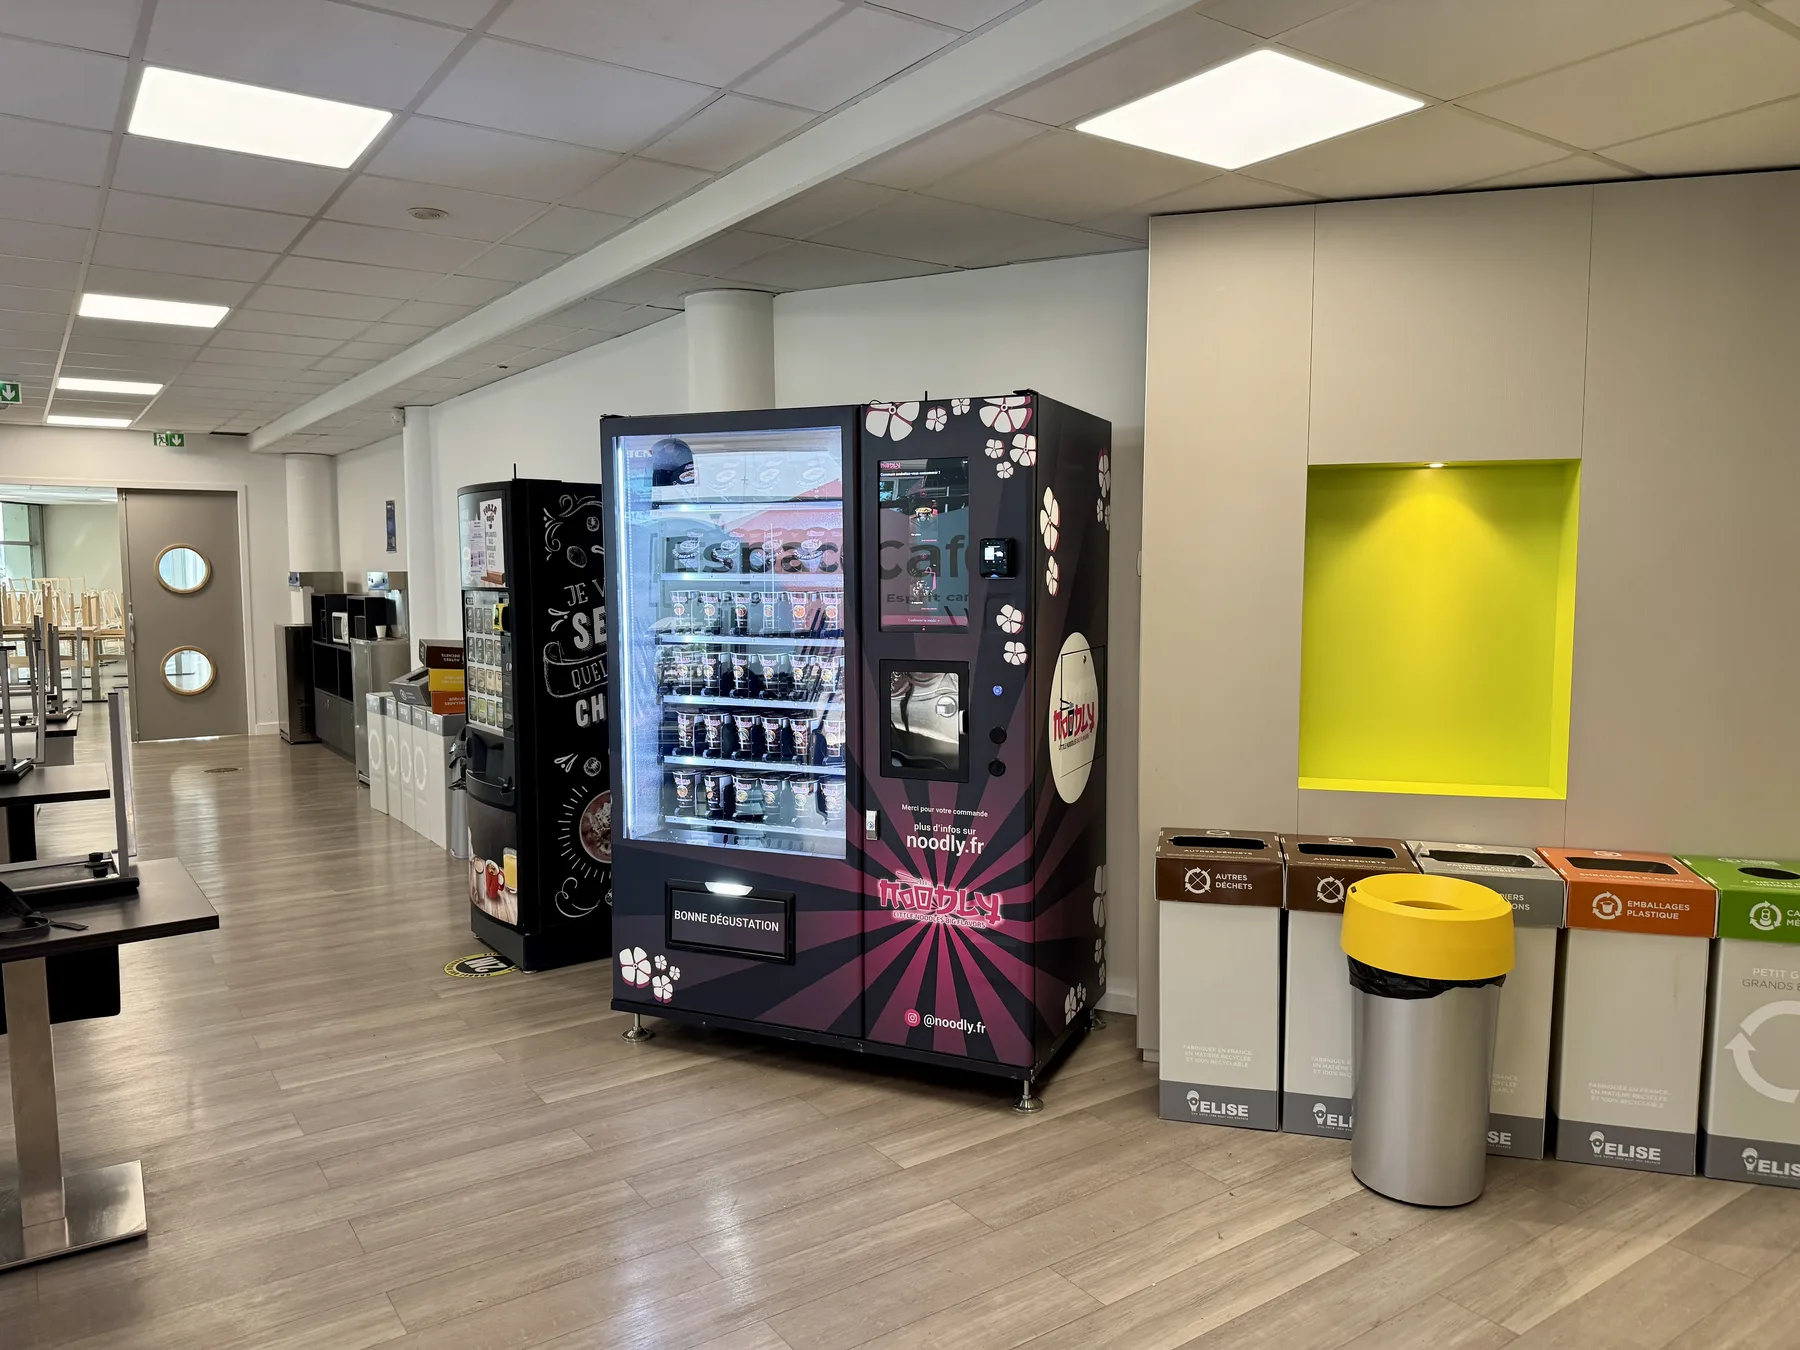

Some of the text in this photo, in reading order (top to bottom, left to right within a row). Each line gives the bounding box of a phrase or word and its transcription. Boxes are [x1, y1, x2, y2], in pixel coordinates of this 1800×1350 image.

[880, 534, 969, 580] caf
[563, 583, 589, 606] JE
[572, 606, 607, 650] SE
[571, 661, 608, 690] QUEL
[901, 804, 988, 817] Merci pour votre commande
[914, 822, 976, 835] plus d'infos sur
[906, 834, 985, 856] noodly.fr
[1215, 873, 1248, 881] AUTRES
[1215, 880, 1253, 890] DÉCHETS
[1626, 900, 1690, 911] EMBALLAGES
[674, 910, 779, 932] BONNE DÉGUSTATION
[915, 913, 944, 923] NOODLES
[957, 918, 987, 929] FLAVORS
[1626, 909, 1680, 920] PLASTIQUE
[1752, 967, 1787, 980] PETIT
[1741, 978, 1794, 992] GRANDS
[923, 1013, 986, 1035] @noodly.fr
[1200, 1100, 1249, 1117] ELISE
[1326, 1113, 1352, 1128] ELI
[1604, 1142, 1661, 1161] ELISE
[1757, 1158, 1800, 1177] ELIS
